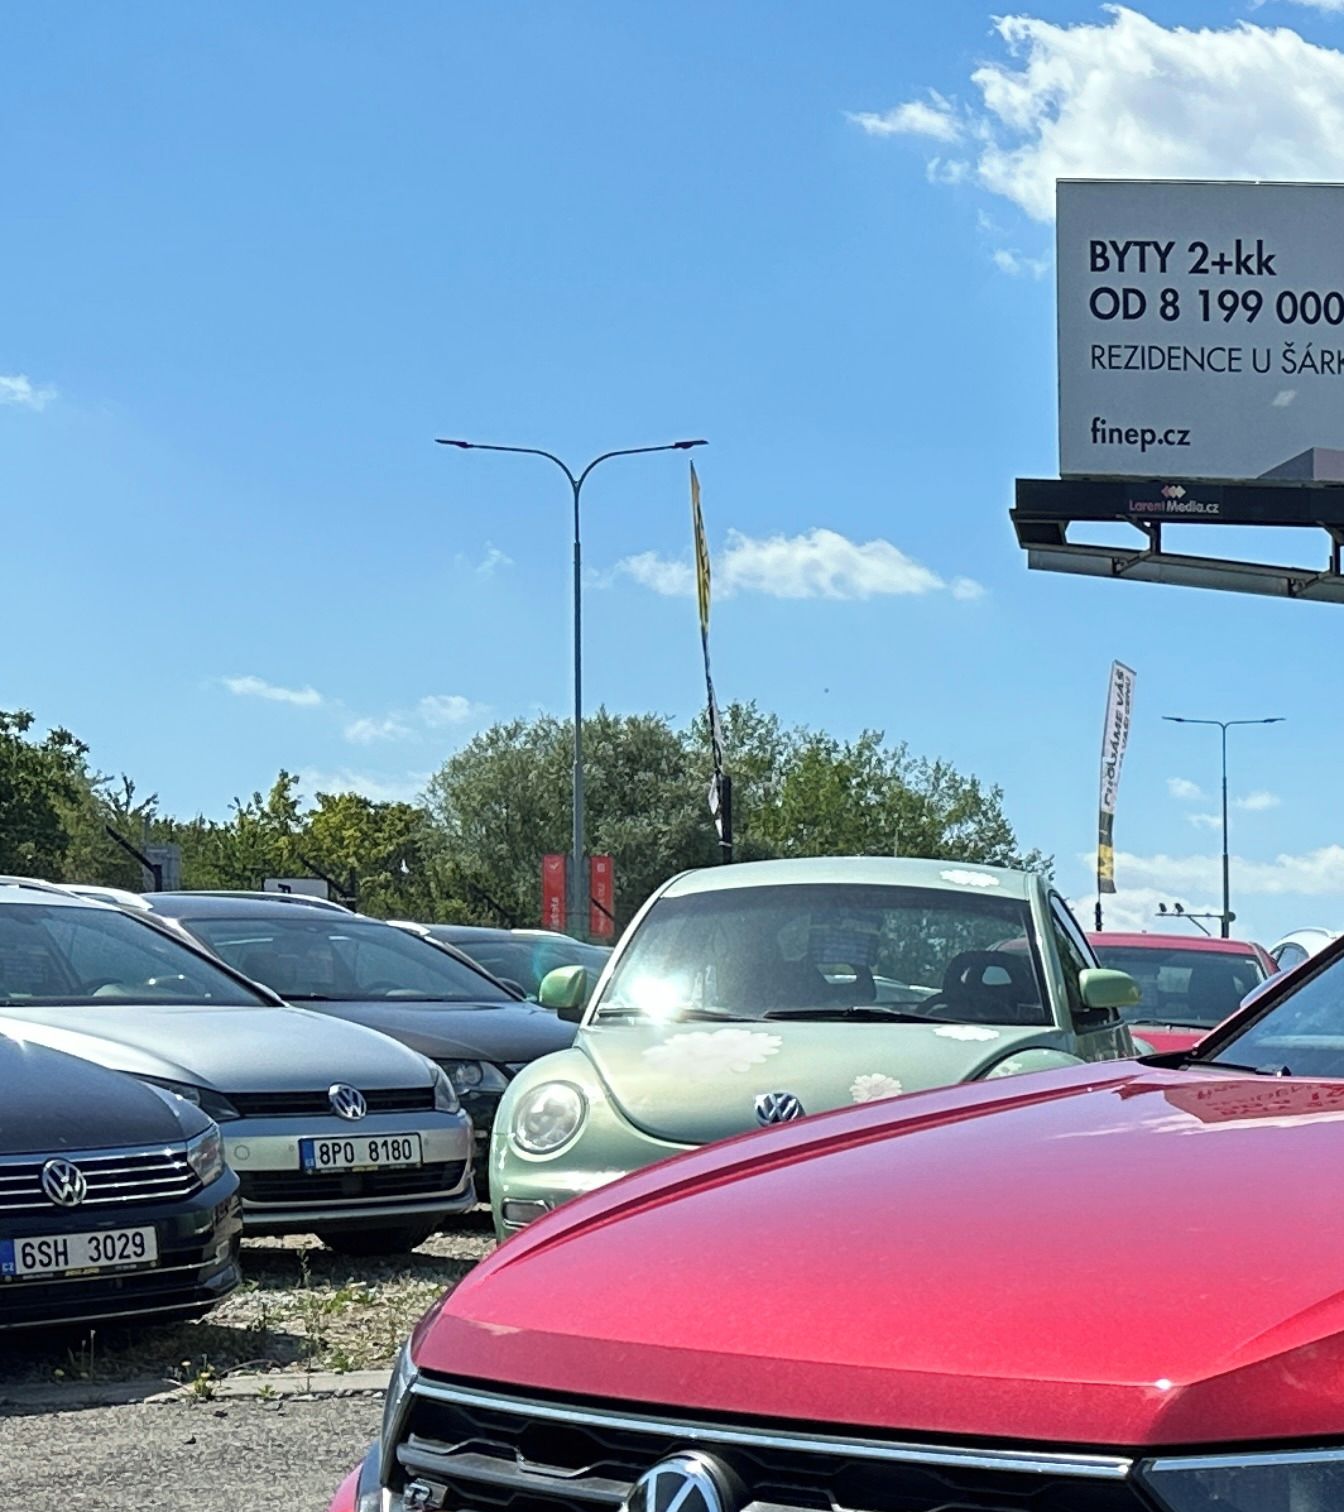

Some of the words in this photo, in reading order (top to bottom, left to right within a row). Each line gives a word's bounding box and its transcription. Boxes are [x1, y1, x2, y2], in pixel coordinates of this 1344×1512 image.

[1089, 240, 1176, 273] BYTY
[1188, 239, 1277, 276] 2+kk
[1089, 287, 1147, 320] OD
[1159, 287, 1180, 321] 8
[1199, 289, 1263, 323] 199
[1091, 344, 1242, 373] REZIDENCE
[1253, 348, 1271, 374] U
[1091, 416, 1191, 451] finep.cz
[368, 1138, 412, 1162] 8180
[21, 1238, 69, 1269] 6SH
[88, 1231, 145, 1262] 3029
